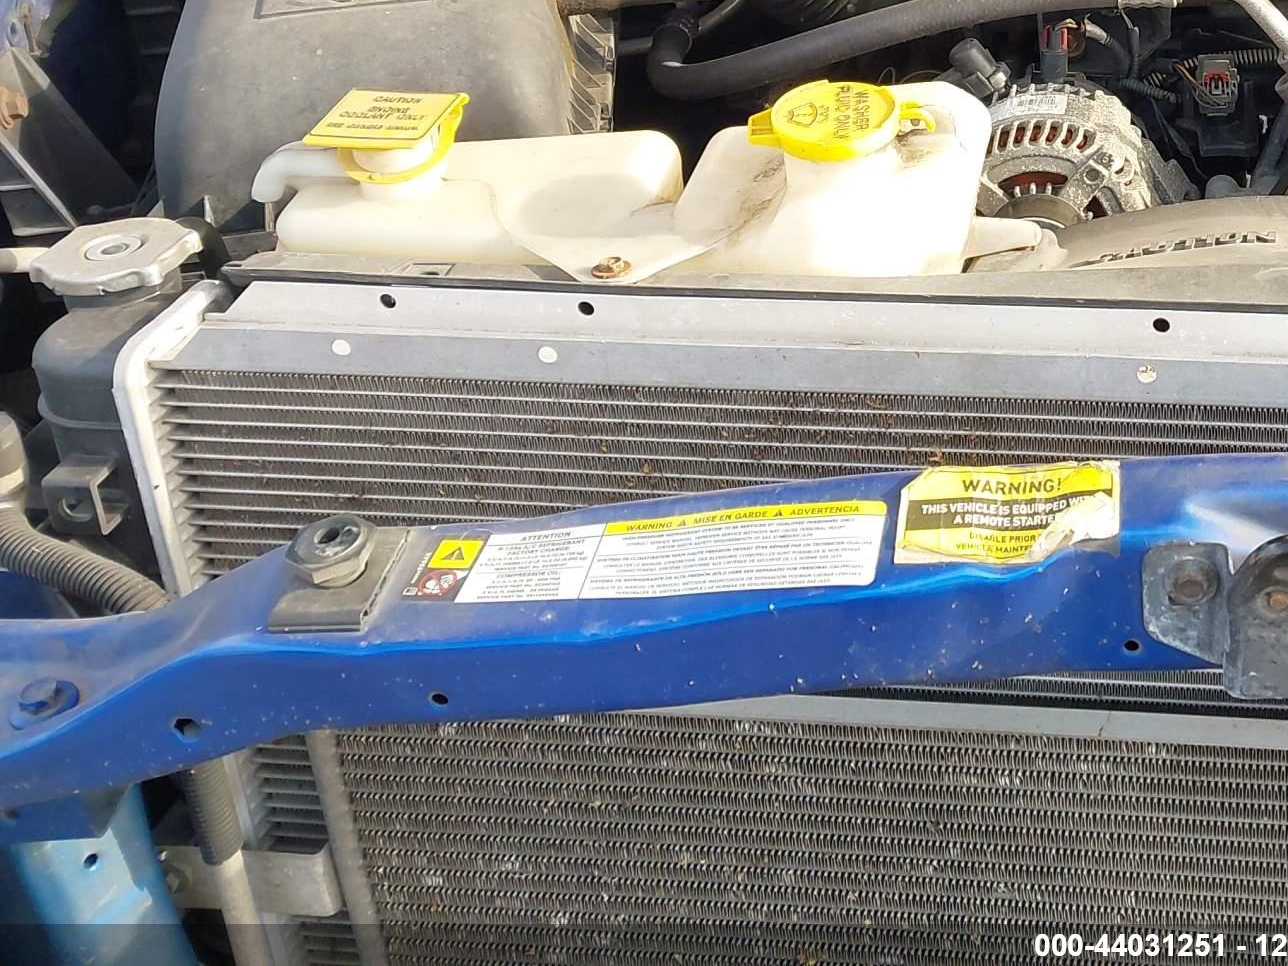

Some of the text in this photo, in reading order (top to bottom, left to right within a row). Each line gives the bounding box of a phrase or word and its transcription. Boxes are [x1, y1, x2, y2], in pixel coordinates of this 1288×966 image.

[373, 95, 424, 104] CAUTION
[852, 88, 871, 132] WASHER
[833, 114, 851, 140] ONLY
[962, 477, 1062, 496] WARNING!
[921, 503, 948, 515] THIS
[949, 501, 996, 515] VEHICLE
[998, 504, 1010, 516] IS
[1012, 498, 1067, 515] EQUIPPED
[626, 505, 860, 532] WARNING MISE EN GARDE ADVERTENCIA
[954, 513, 1056, 527] A REMOTE STARTE
[520, 531, 572, 542] ATTENTION
[1009, 535, 1037, 544] PRIOR
